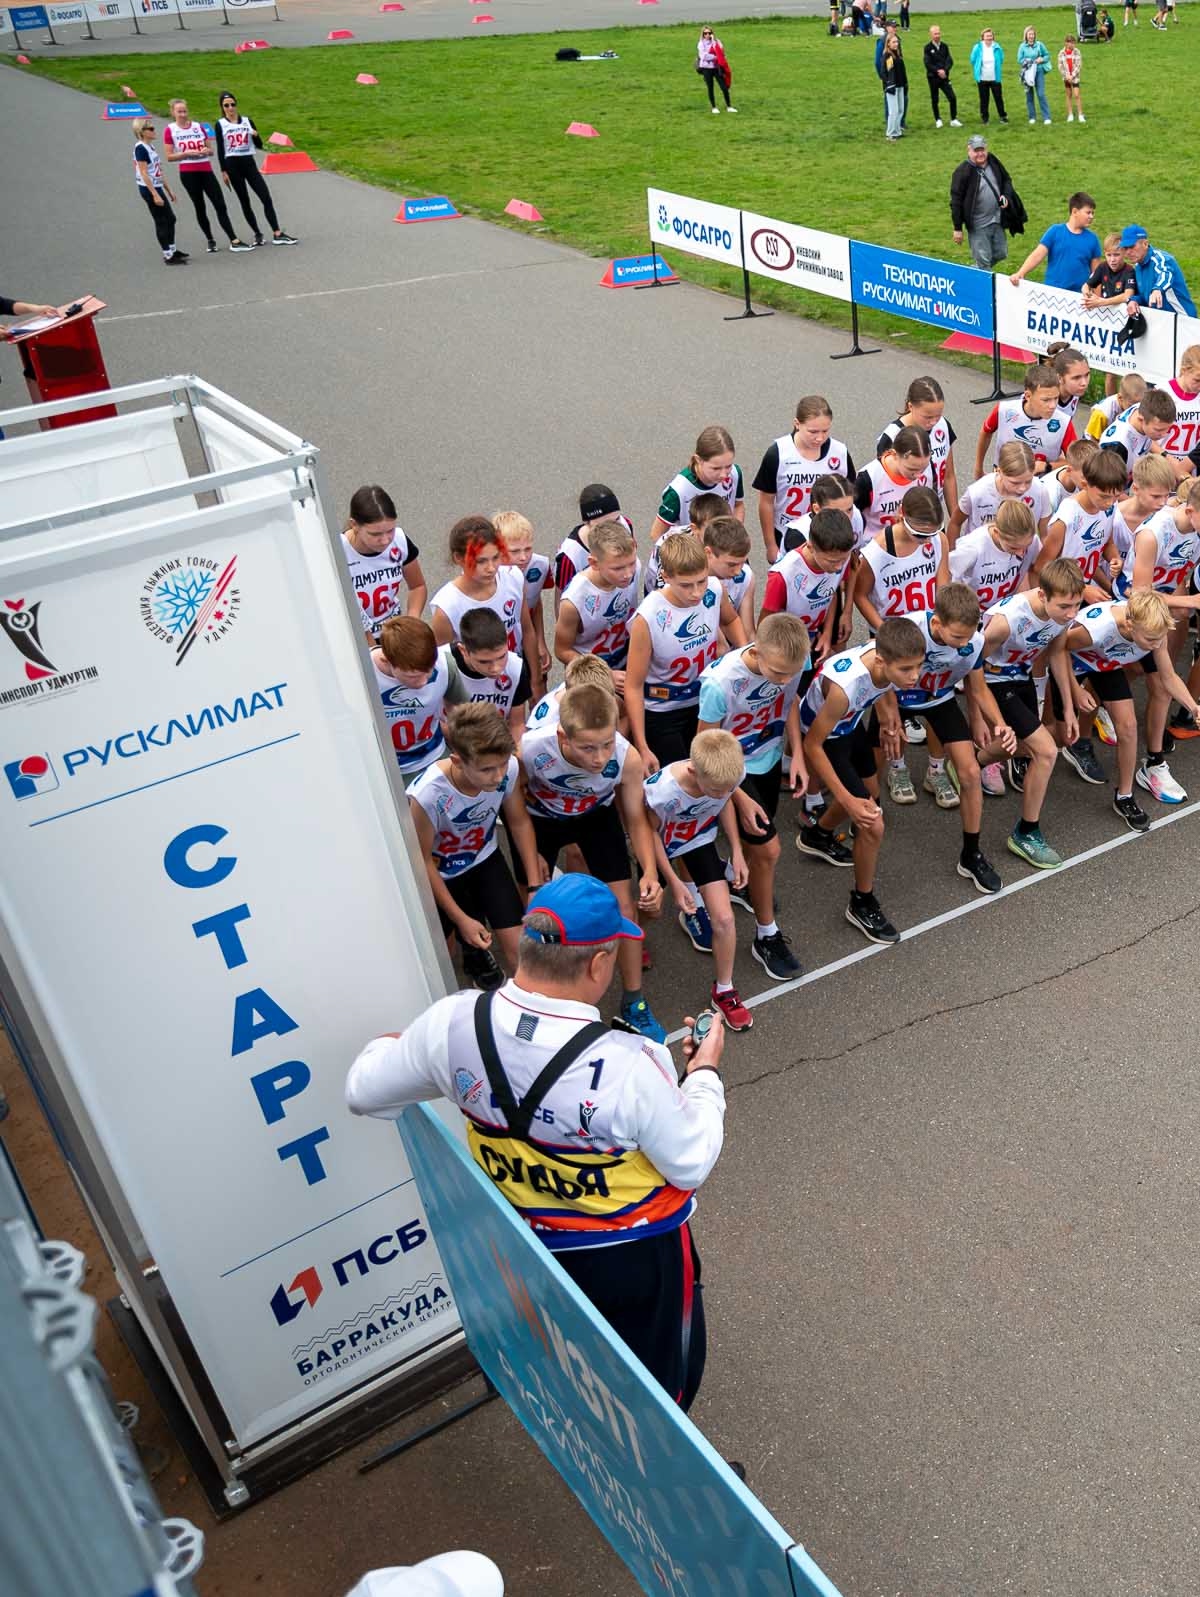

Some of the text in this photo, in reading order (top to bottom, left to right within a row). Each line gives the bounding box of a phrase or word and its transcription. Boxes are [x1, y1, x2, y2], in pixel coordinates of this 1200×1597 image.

[152, 1, 168, 10] ПСБ
[227, 133, 250, 148] 294
[672, 216, 732, 250] ФОСАГРО
[882, 263, 956, 297] ТЕХНОПАРК
[862, 281, 932, 314] РУСКЛИМАТ
[1027, 310, 1136, 357] БАРРАКУДА
[1110, 357, 1137, 369] ЦЕНТР
[786, 473, 822, 486] УДМУР
[883, 561, 936, 588] УДМУРТИЯ
[979, 565, 1022, 587] УДМУРТИ
[140, 556, 219, 644] ФЕДЕРАЦИЯ ЛЫЖНЫХ ГОНОК
[204, 588, 241, 643] УДМУРТИИ
[683, 636, 708, 651] СТРИЖ
[0, 665, 99, 706] ИНСПОРТ УДМУРТИИ
[63, 683, 288, 777] РУСКЛИМАТ
[385, 708, 417, 719] СТРИЖ
[731, 692, 785, 738] 231
[437, 826, 486, 855] 23
[163, 824, 330, 1186] СТАРТ
[588, 1057, 605, 1091] 1
[533, 1106, 555, 1126] СБ
[479, 1143, 610, 1201] СУДЬЯ
[332, 1218, 428, 1287] ПСБ
[296, 1286, 448, 1377] БАРРАКУДА
[303, 1300, 452, 1386] ОРТОДОНТИЧЕСКИЙ ЦЕНТР
